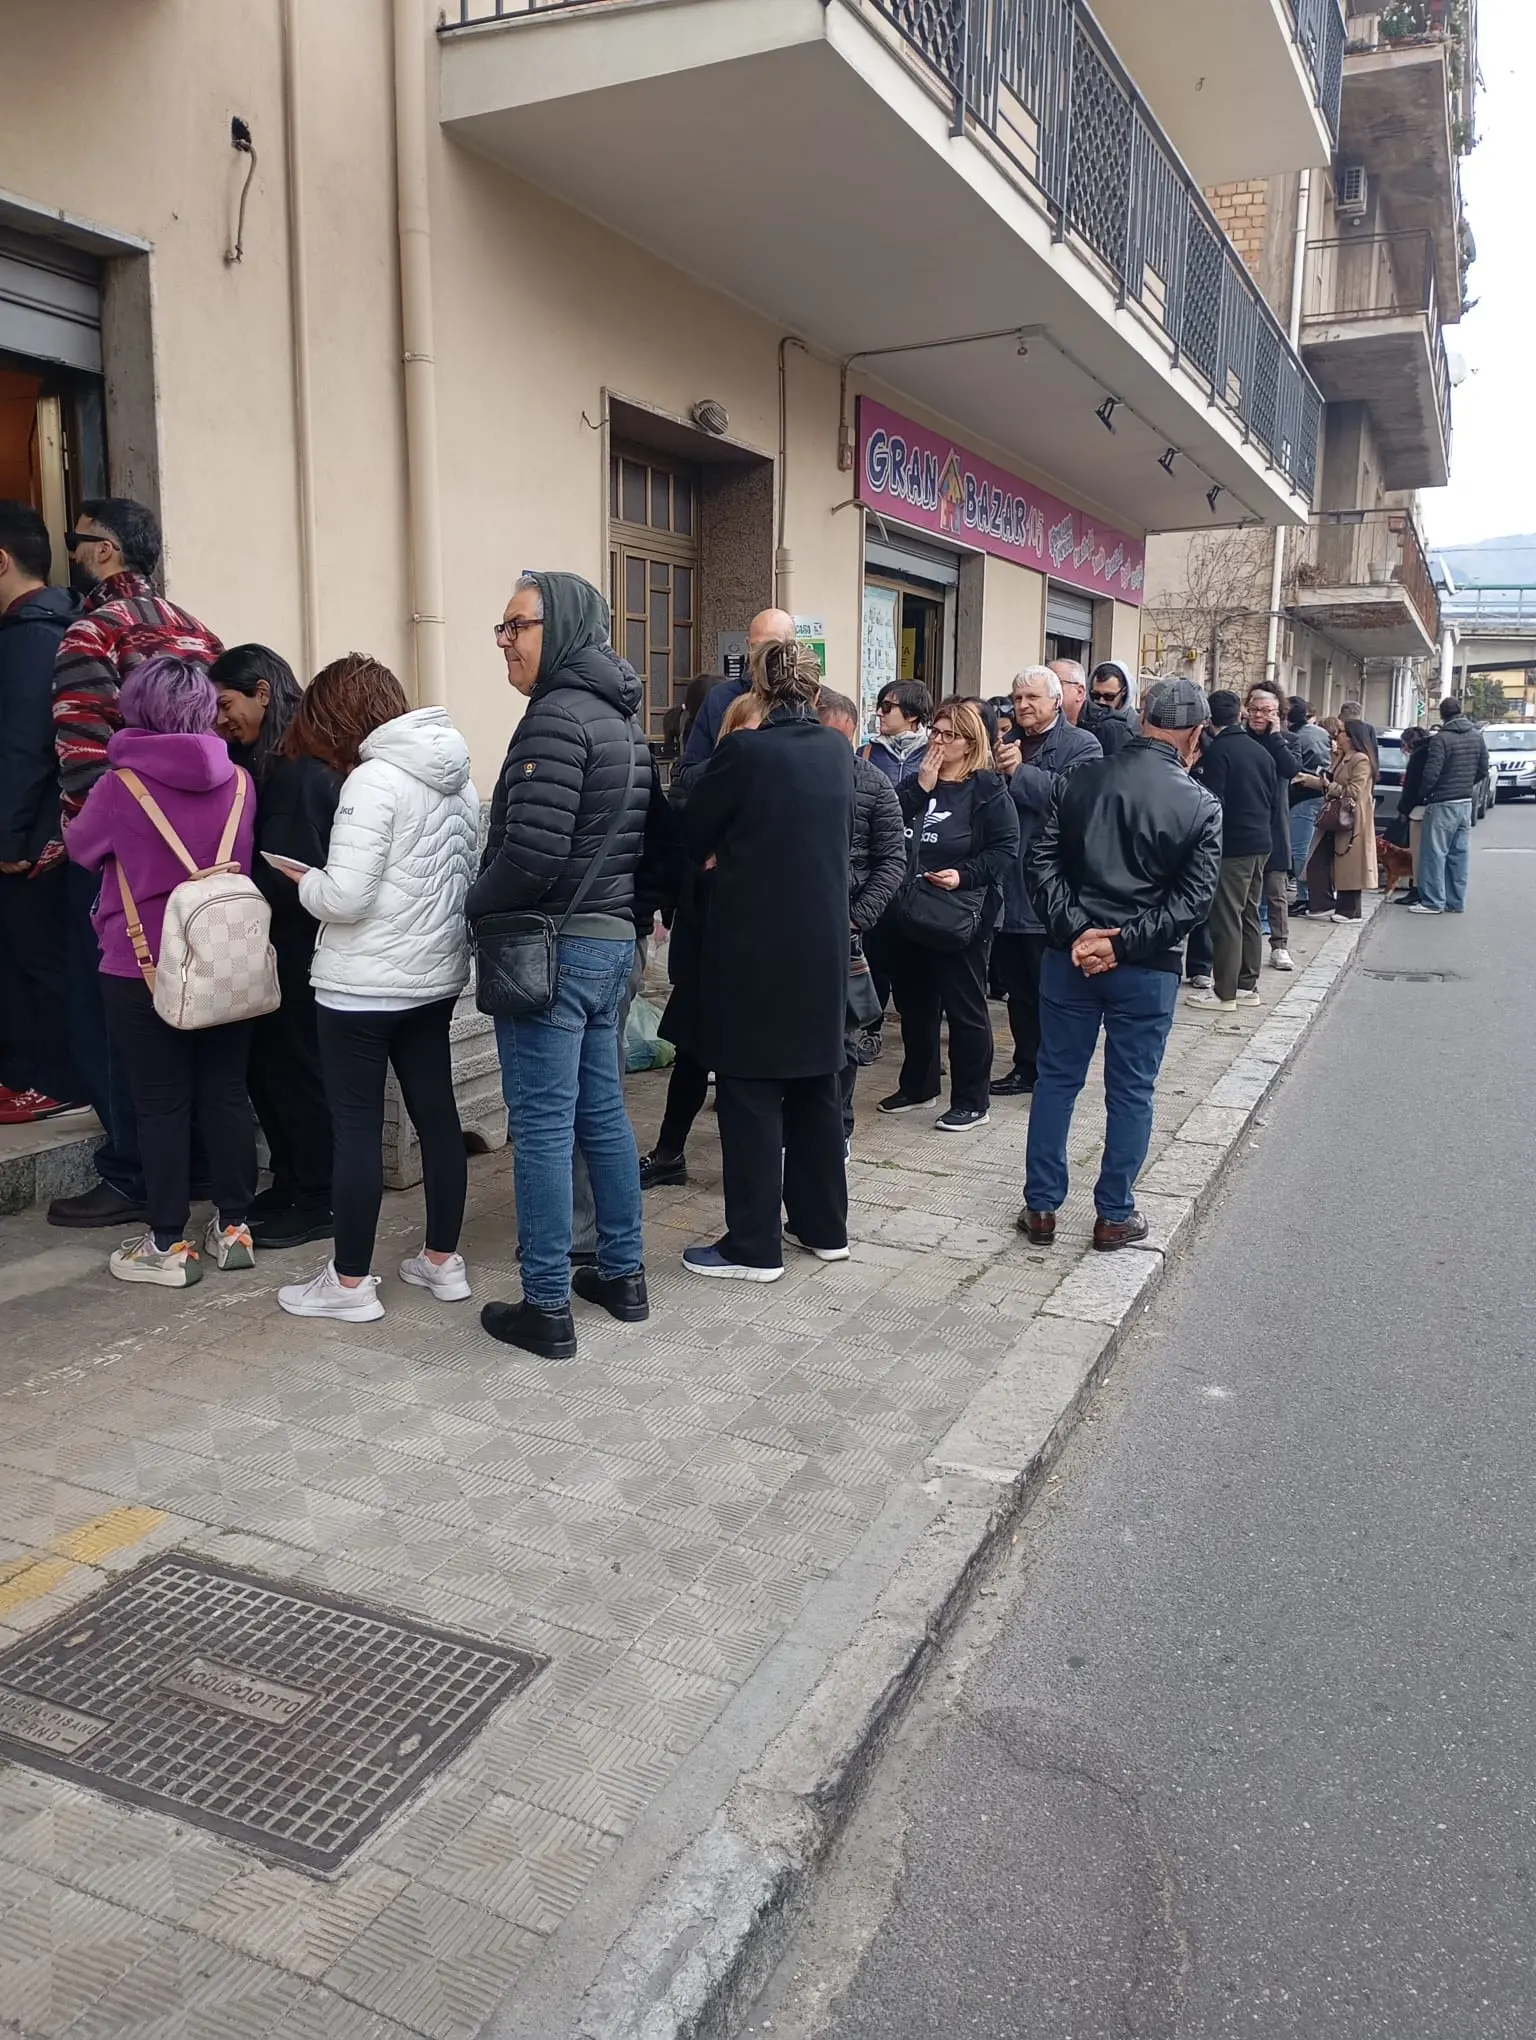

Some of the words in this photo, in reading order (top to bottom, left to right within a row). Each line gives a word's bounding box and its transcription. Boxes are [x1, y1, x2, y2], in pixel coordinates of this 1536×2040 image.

[866, 429, 938, 511] GRAN
[964, 471, 1027, 547] BAZAR
[174, 1668, 301, 1714] ACQUEDOTTO
[0, 1713, 61, 1742] LERNO
[48, 1712, 101, 1735] PISANO
